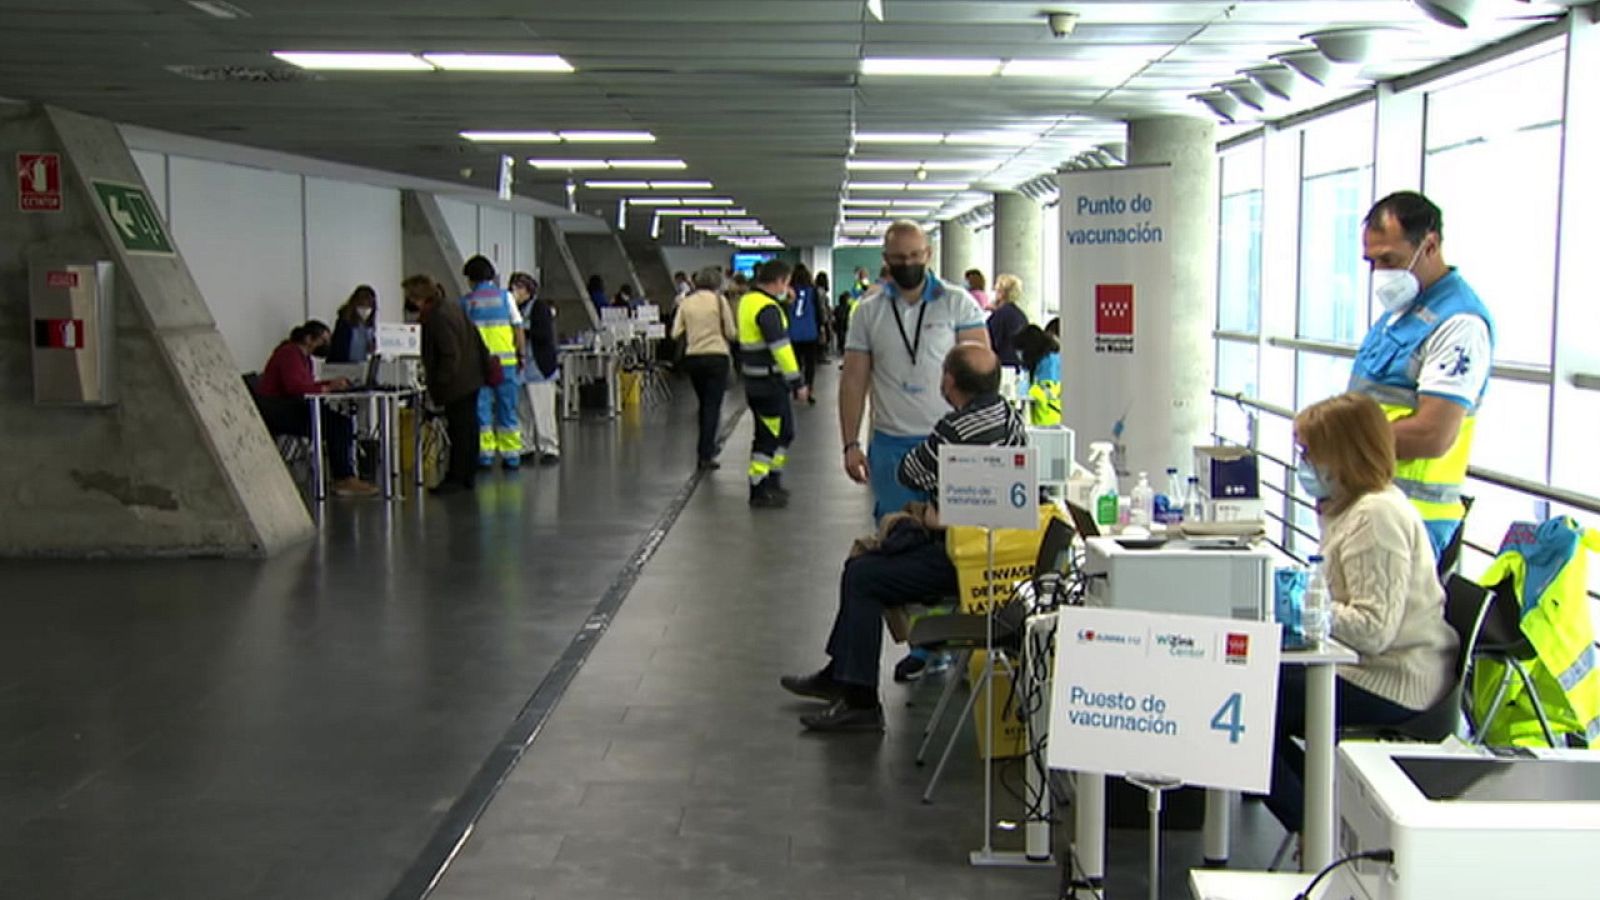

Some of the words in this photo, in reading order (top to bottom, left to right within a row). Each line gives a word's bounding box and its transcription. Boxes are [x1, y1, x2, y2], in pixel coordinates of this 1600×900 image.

[1077, 196, 1127, 215] Punto
[1131, 194, 1152, 213] de
[1067, 222, 1163, 244] vacunación
[1010, 481, 1027, 509] 6
[983, 564, 1036, 582] ENVASE
[1070, 686, 1136, 711] Puesto
[1142, 694, 1166, 714] de
[1069, 709, 1177, 736] vacunación
[1210, 692, 1246, 744] 4
